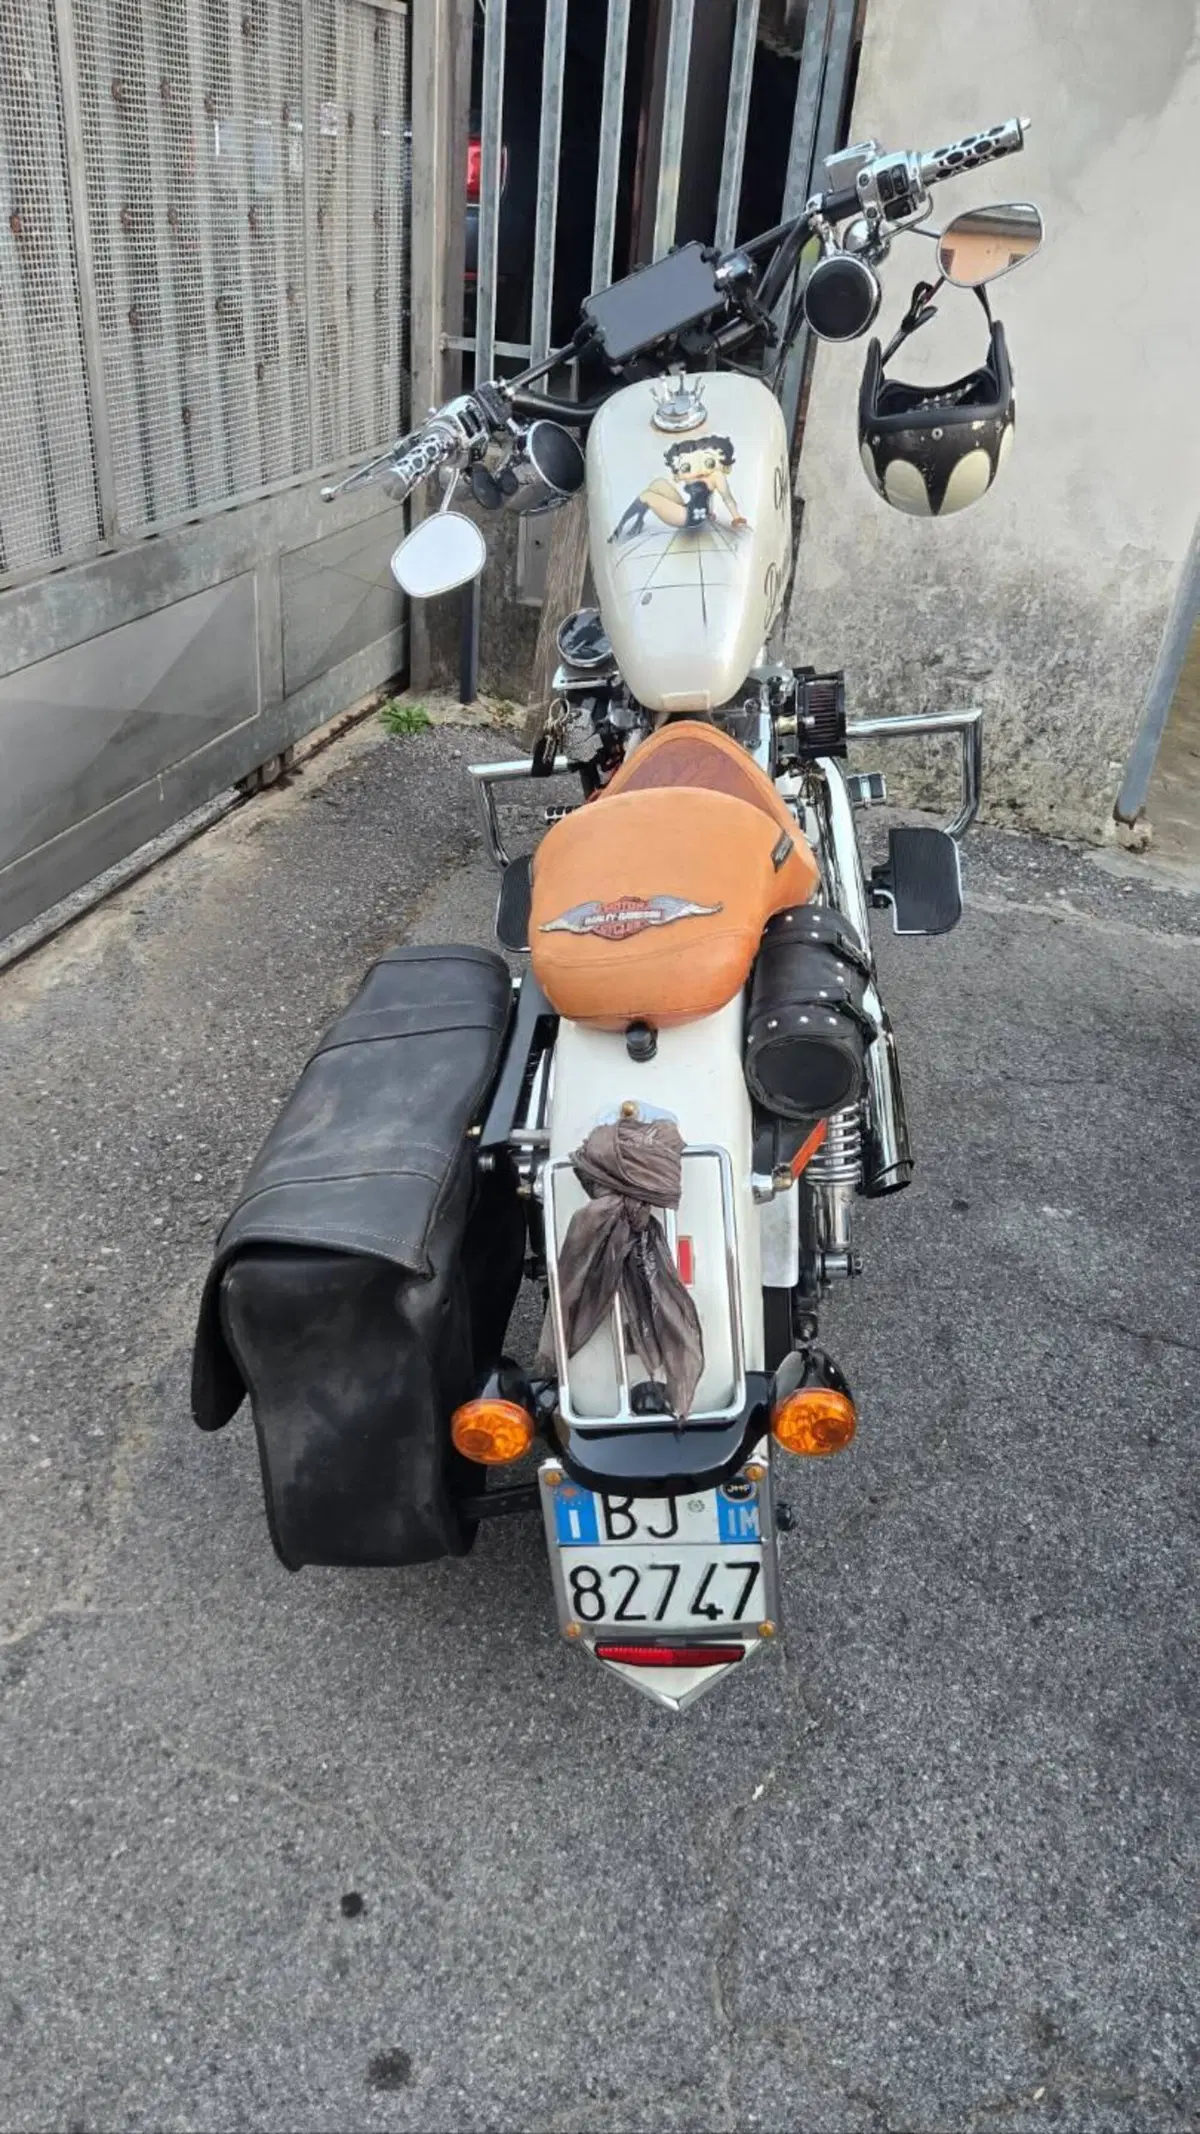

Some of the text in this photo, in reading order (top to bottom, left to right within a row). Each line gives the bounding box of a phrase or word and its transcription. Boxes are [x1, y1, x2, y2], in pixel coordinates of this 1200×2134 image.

[568, 1496, 760, 1540] I BJ IM
[569, 1562, 760, 1621] 82747
